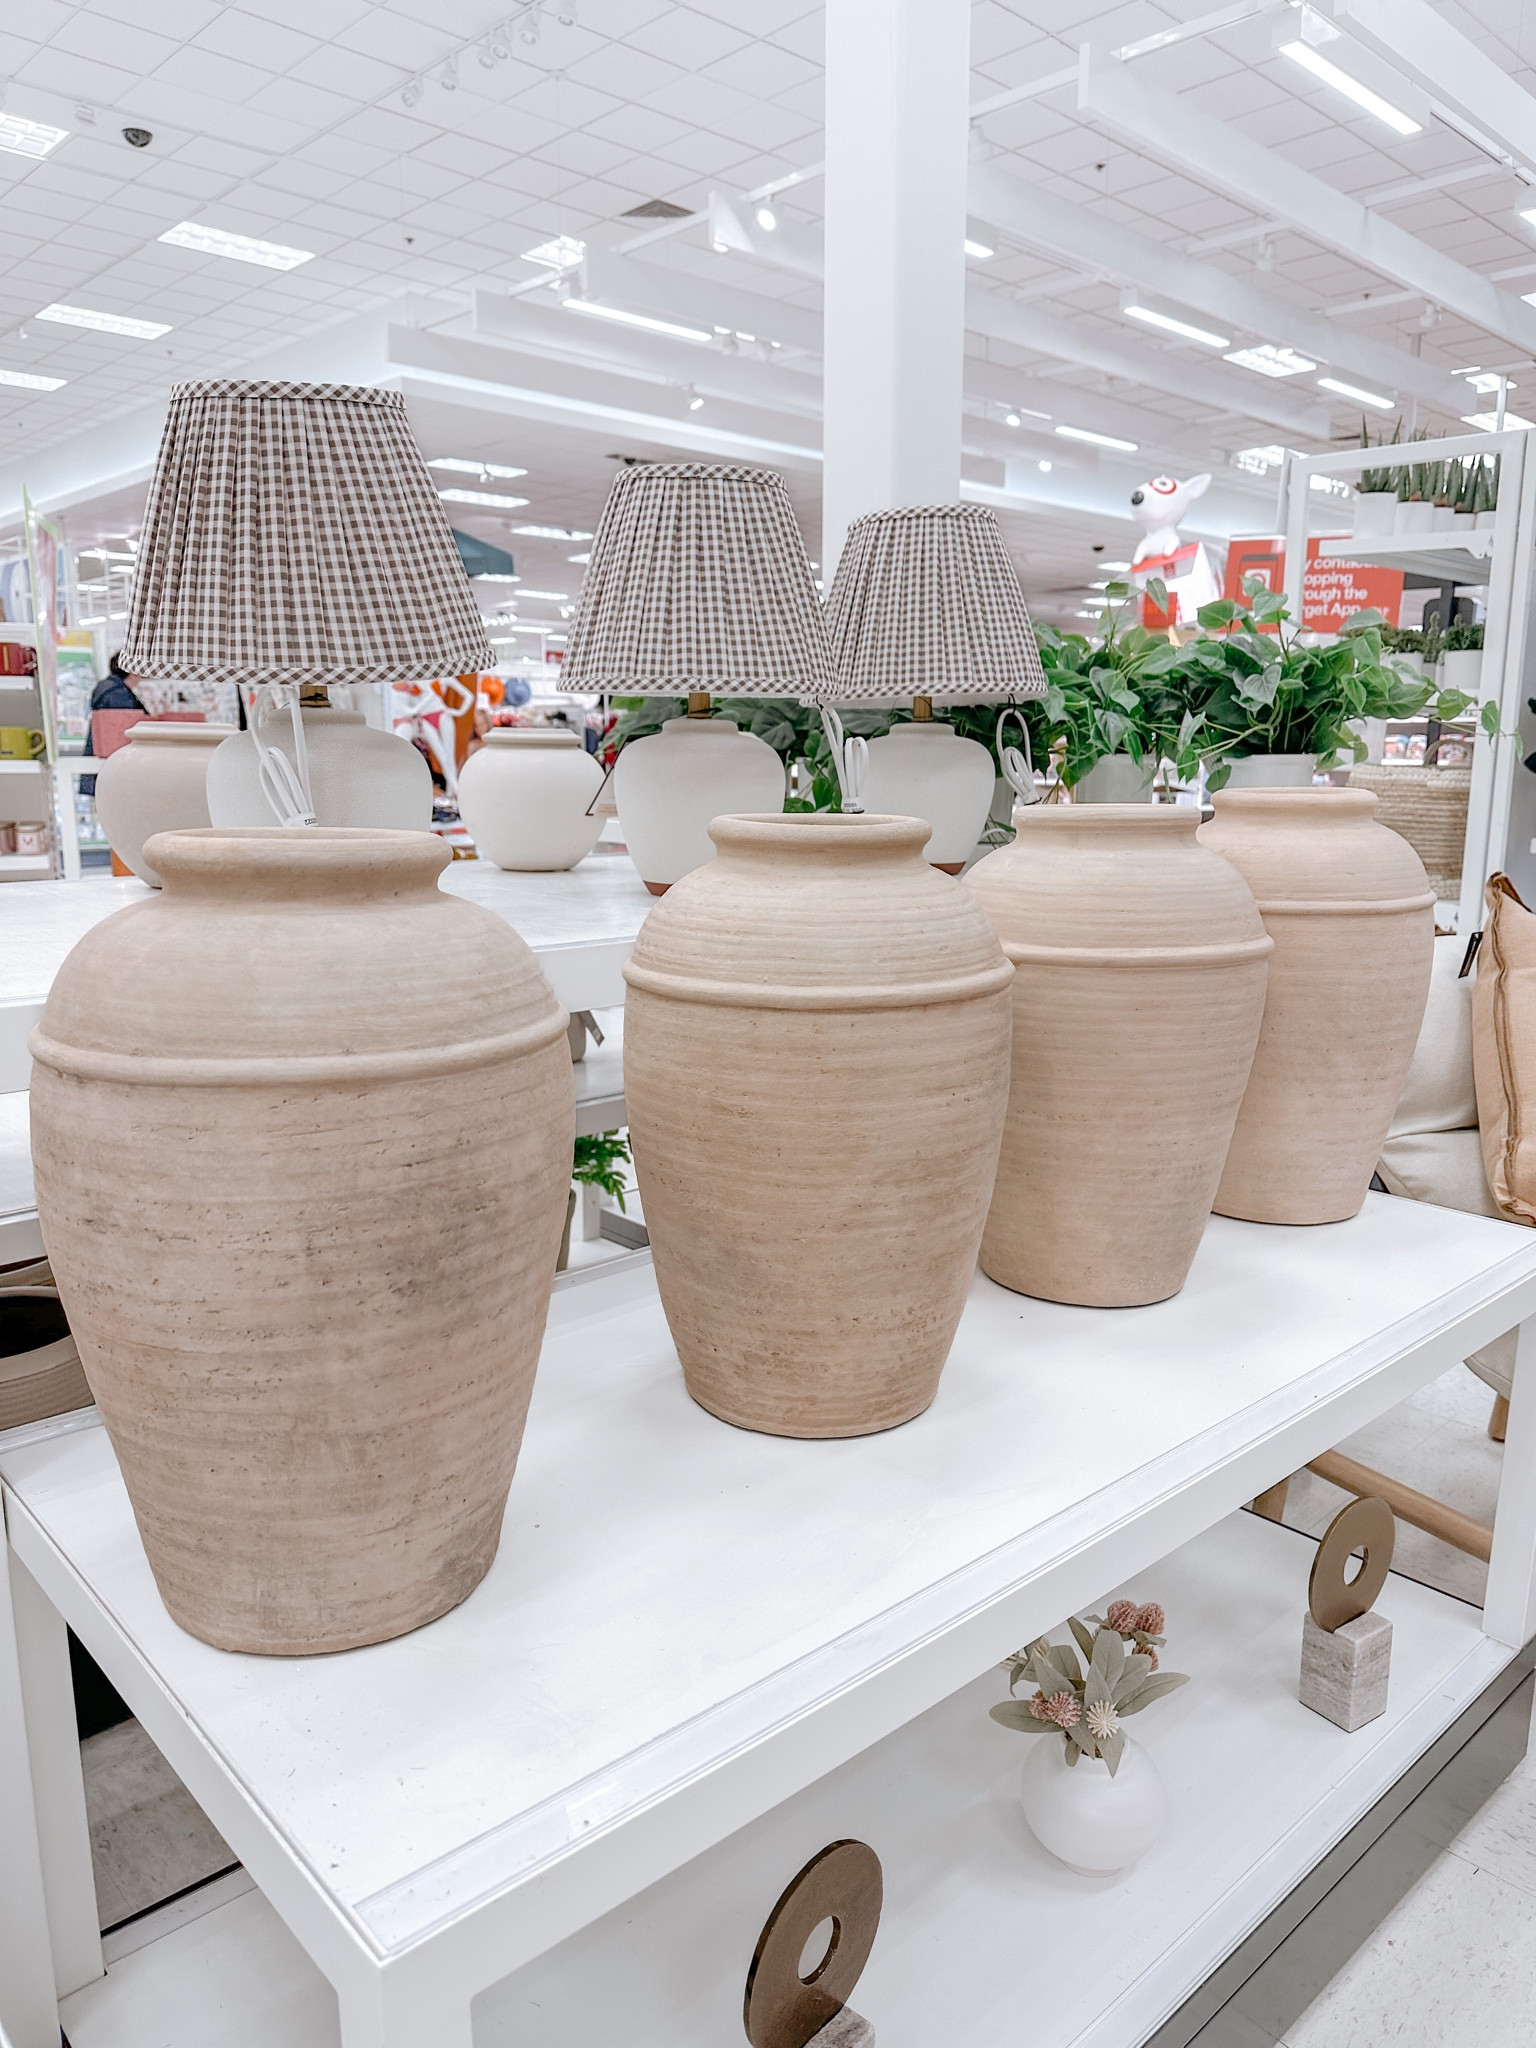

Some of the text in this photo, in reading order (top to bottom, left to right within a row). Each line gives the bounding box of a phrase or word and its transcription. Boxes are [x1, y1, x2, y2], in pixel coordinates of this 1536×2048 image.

[1303, 586, 1368, 604] ough the
[1303, 603, 1329, 619] get
